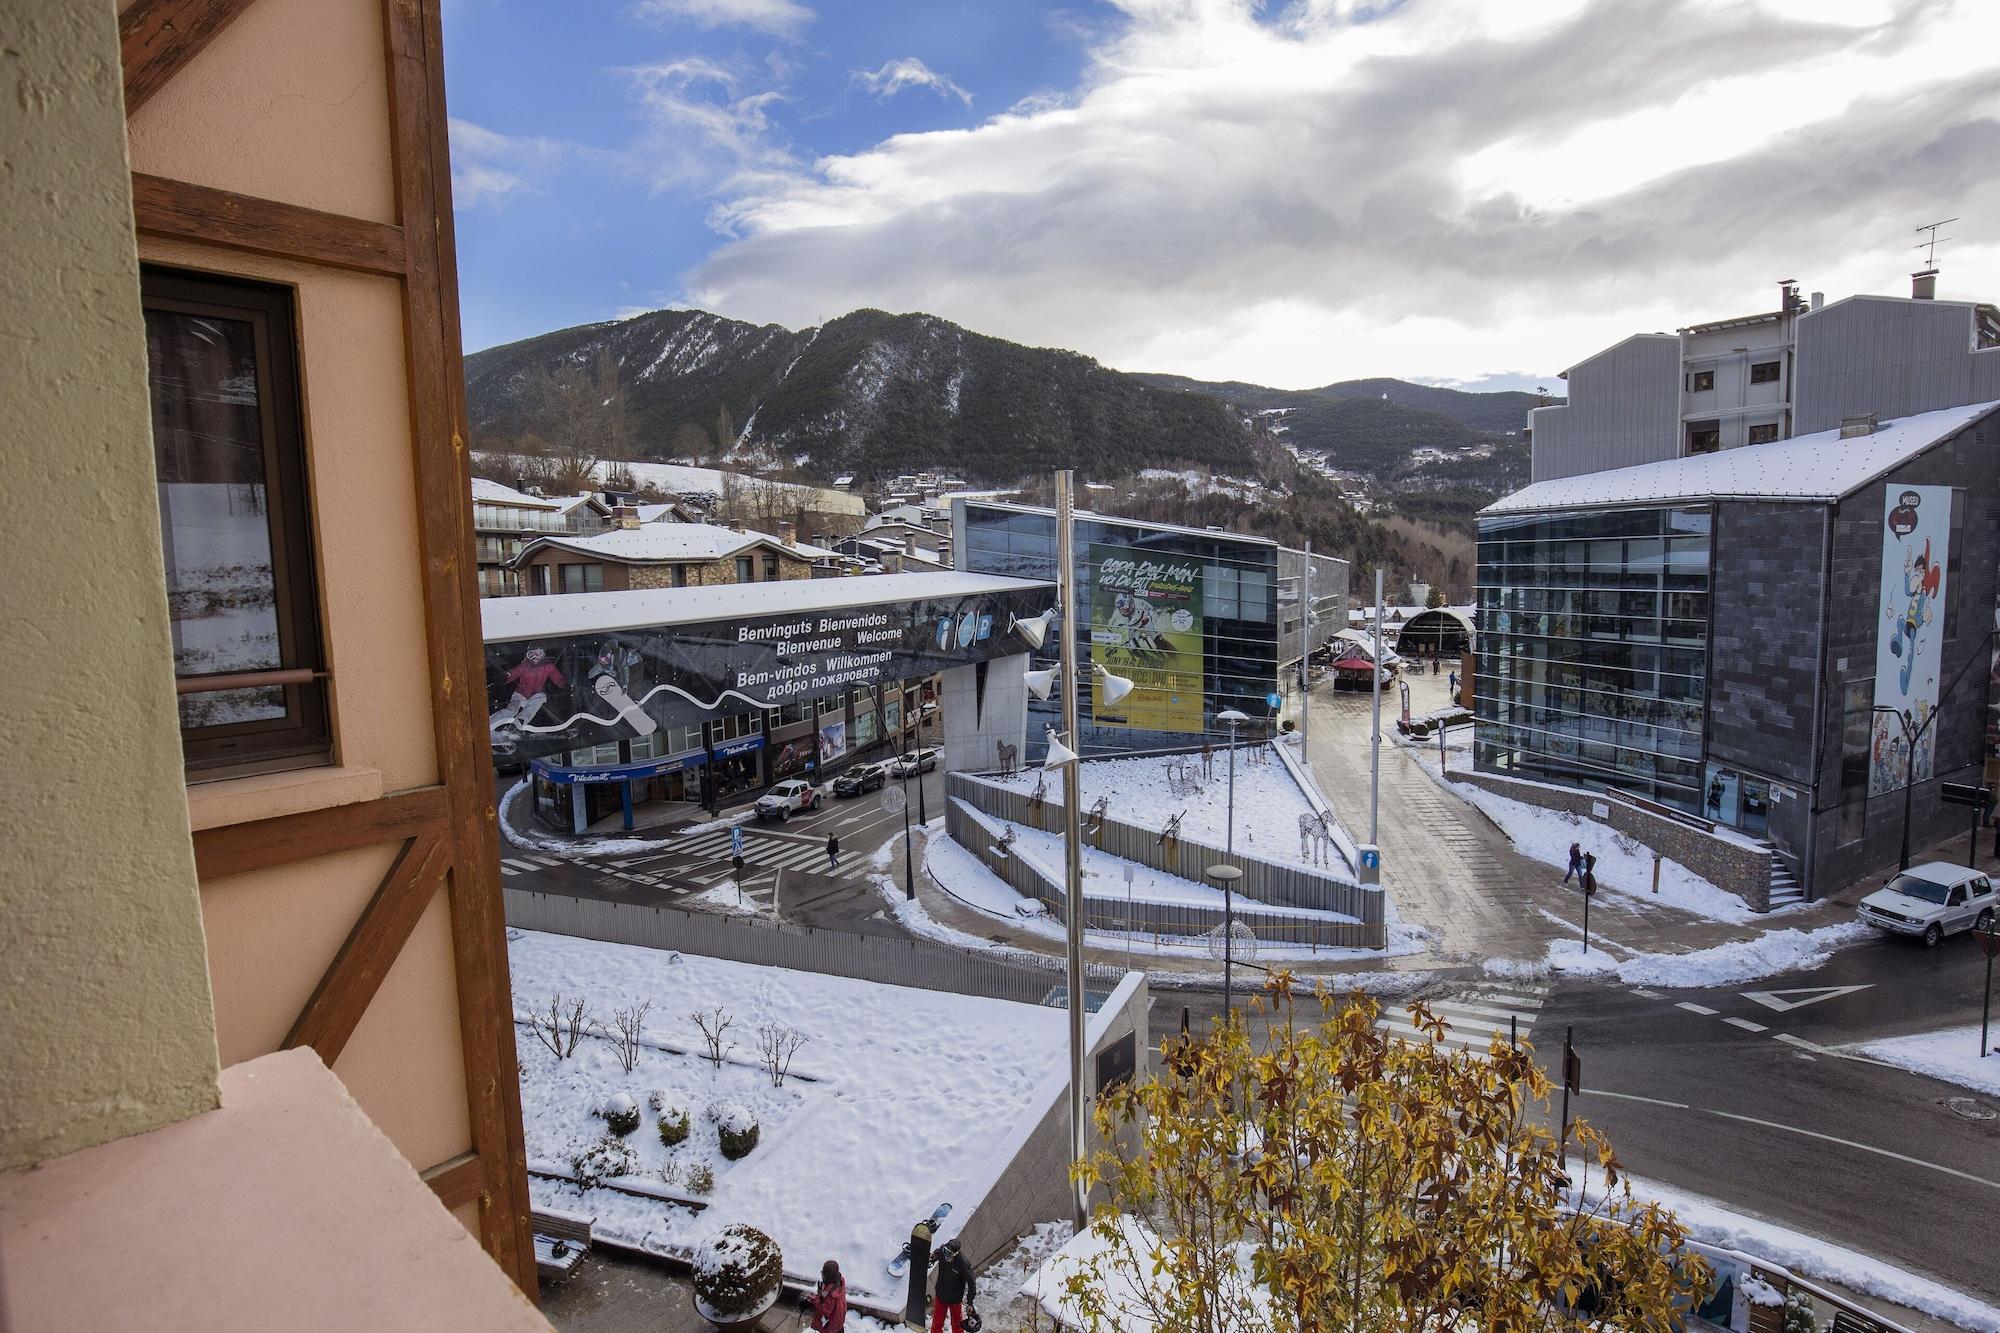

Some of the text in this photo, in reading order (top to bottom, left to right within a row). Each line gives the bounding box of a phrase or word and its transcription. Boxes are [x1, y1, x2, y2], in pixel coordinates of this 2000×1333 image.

[738, 613, 888, 642] Benvinguts Bienvenidos
[776, 627, 903, 656] Bienvenue Welcome
[737, 651, 892, 688] Bem-vindos Willkommen
[767, 666, 880, 700] добро пожаловать
